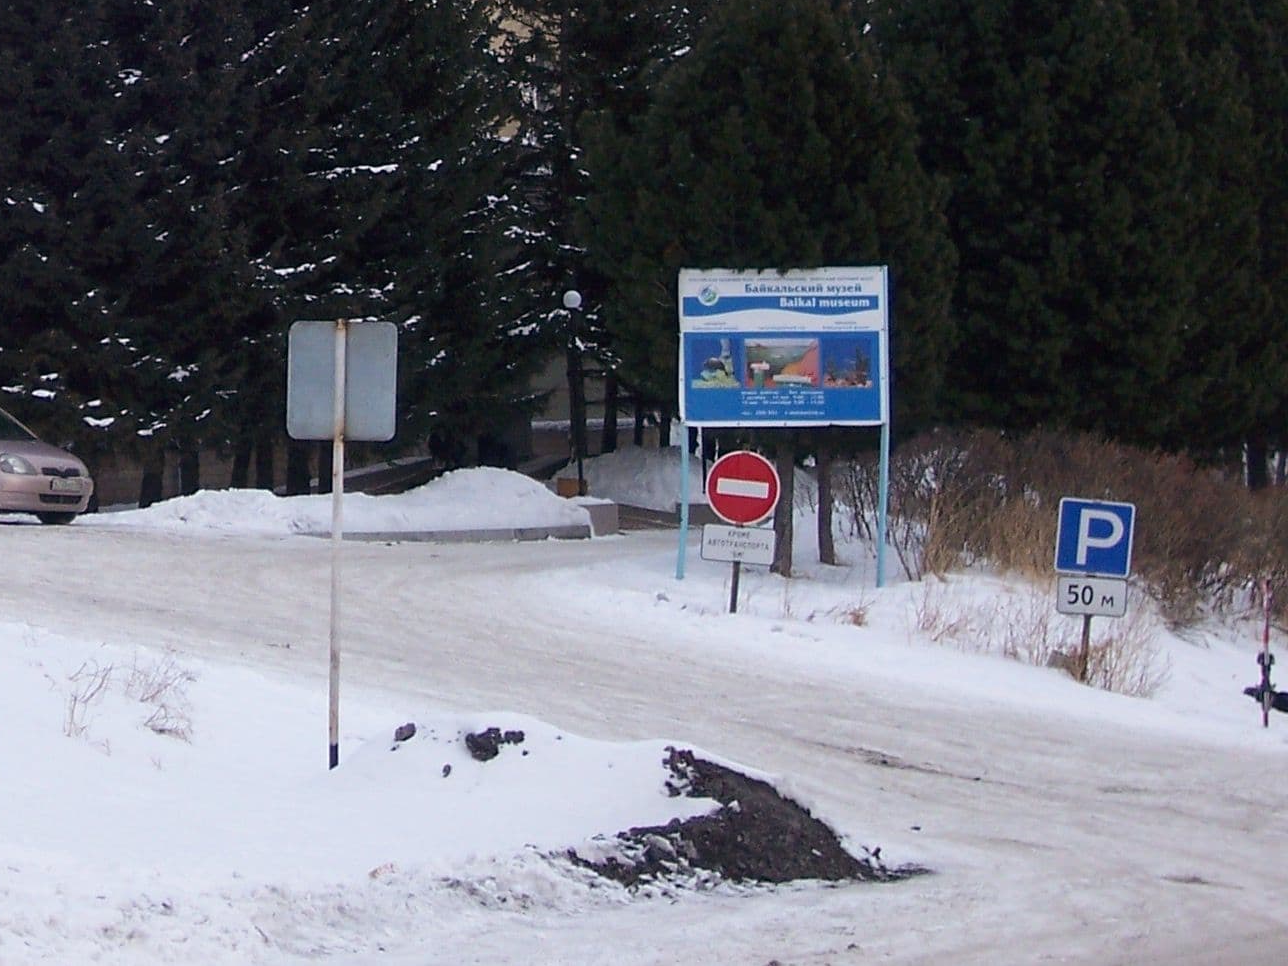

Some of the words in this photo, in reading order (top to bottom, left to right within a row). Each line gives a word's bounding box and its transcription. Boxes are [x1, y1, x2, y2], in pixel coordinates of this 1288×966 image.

[744, 283, 824, 293] Байкальский
[826, 283, 862, 295] музей
[779, 297, 816, 308] Baikal
[819, 298, 870, 308] museum
[1076, 508, 1124, 565] P
[1067, 584, 1094, 605] 50
